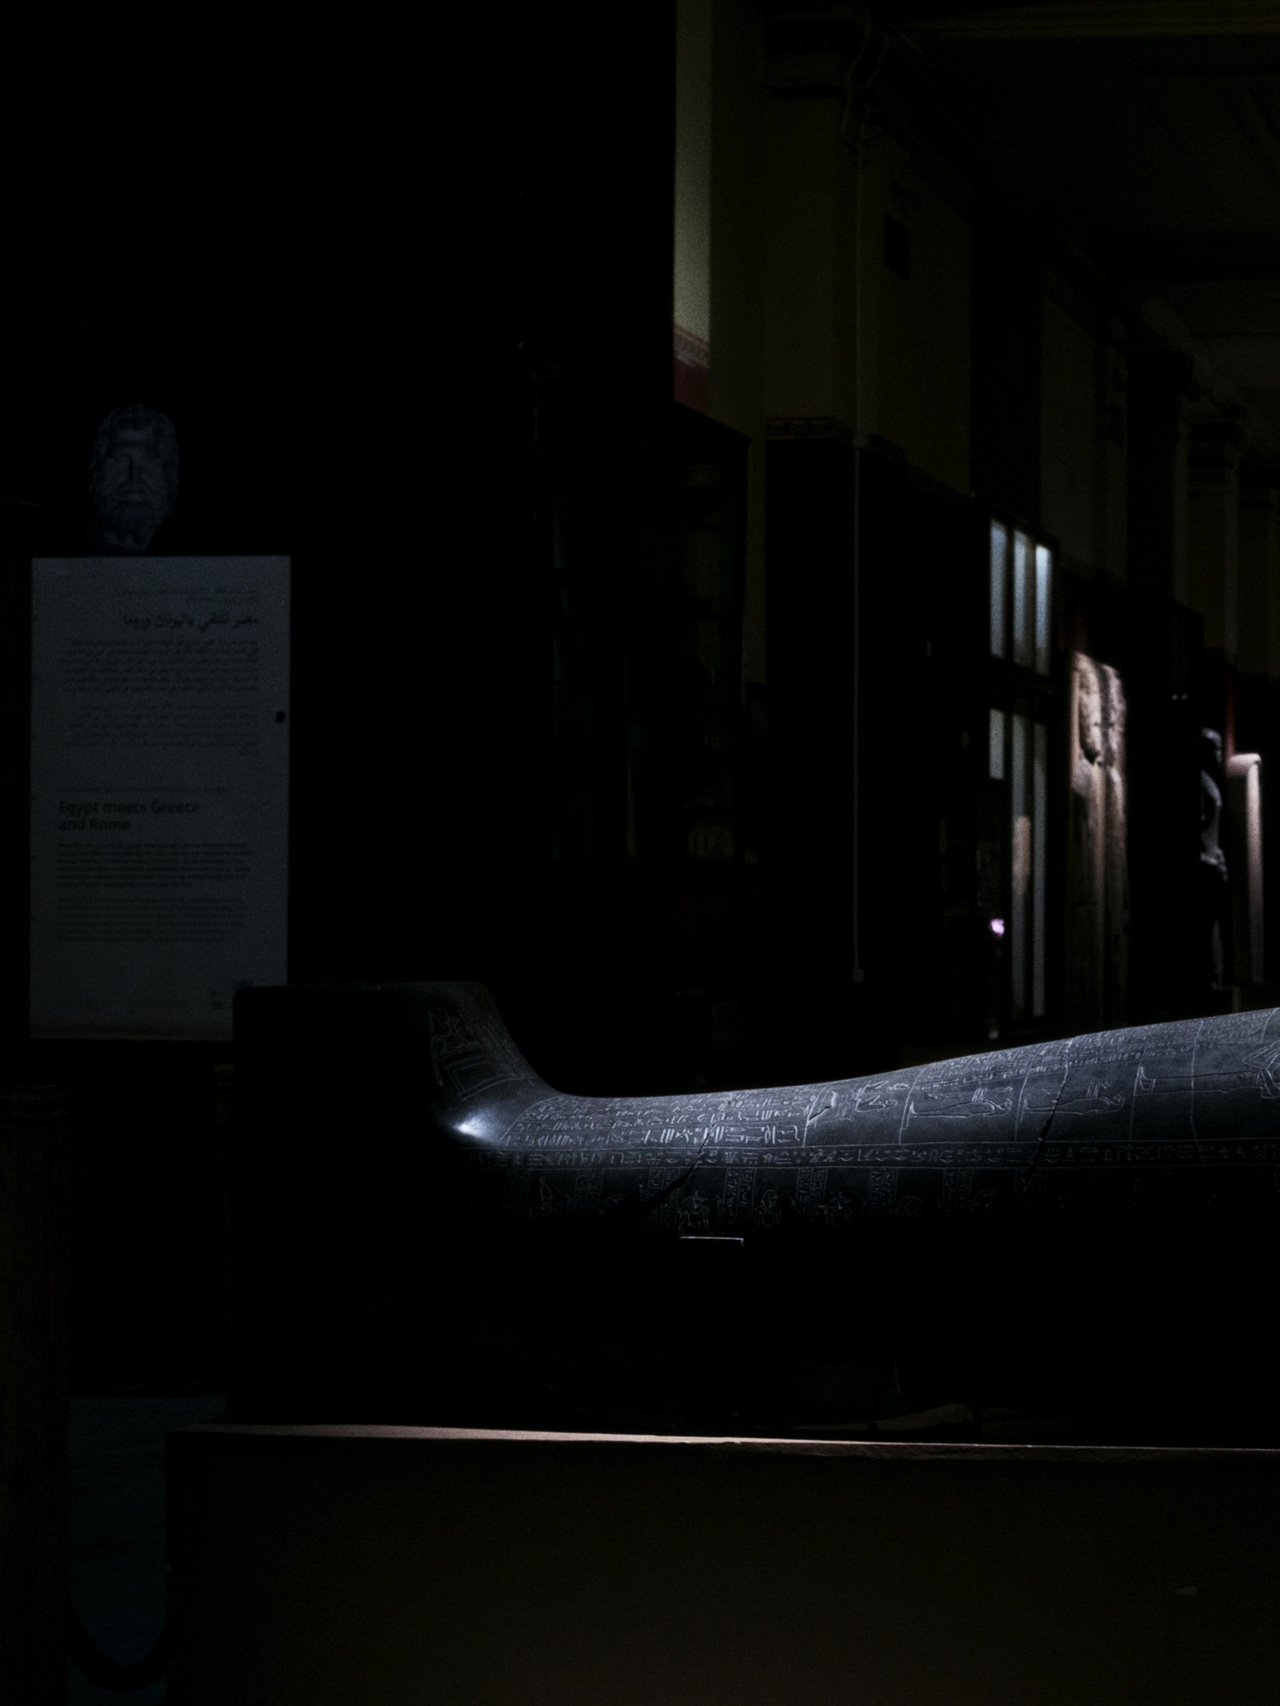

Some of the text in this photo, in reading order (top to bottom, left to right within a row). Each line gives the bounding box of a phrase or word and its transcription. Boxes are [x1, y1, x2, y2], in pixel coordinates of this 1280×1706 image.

[232, 615, 259, 629] مصر
[58, 801, 199, 818] Egypt meets Greece
[58, 818, 131, 831] and Rome
